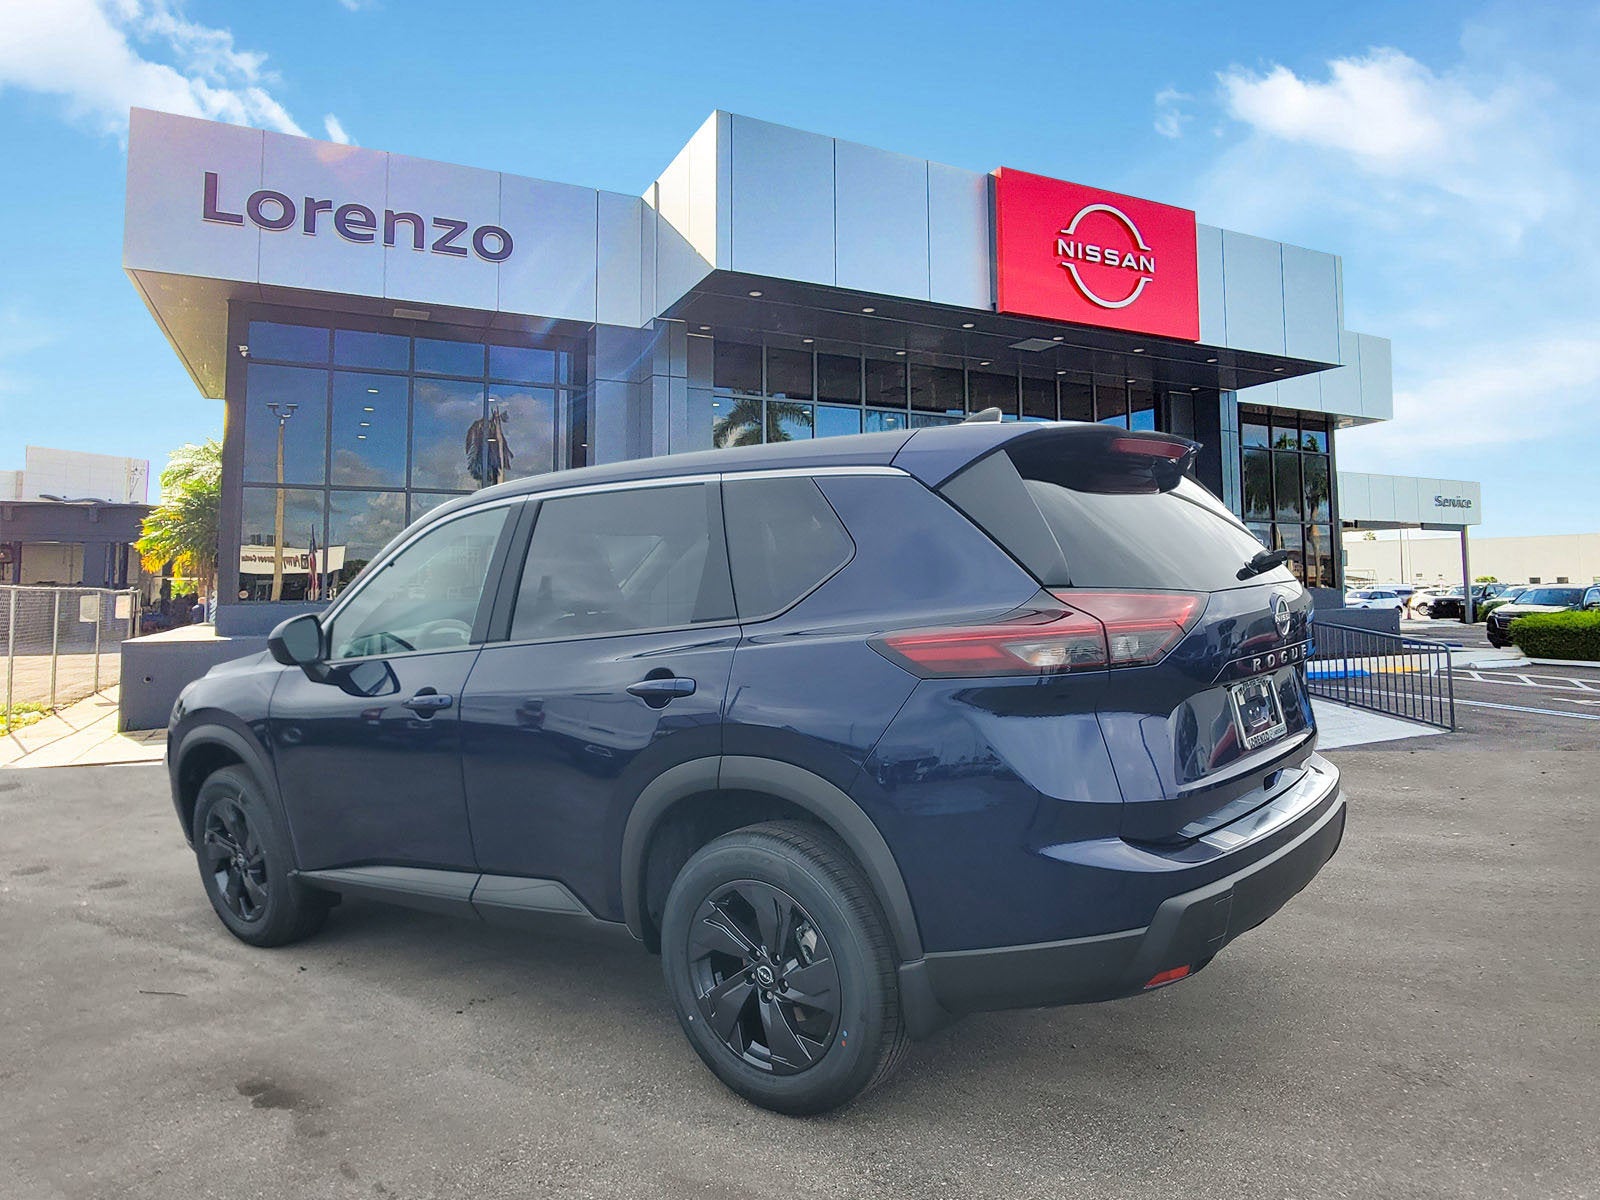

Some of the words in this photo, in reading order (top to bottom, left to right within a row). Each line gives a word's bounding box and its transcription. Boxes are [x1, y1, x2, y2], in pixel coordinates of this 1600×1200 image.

[203, 171, 514, 262] Lorenzo
[1057, 238, 1155, 273] NISSAN
[1434, 495, 1472, 508] Service
[1252, 644, 1307, 672] ROGUE
